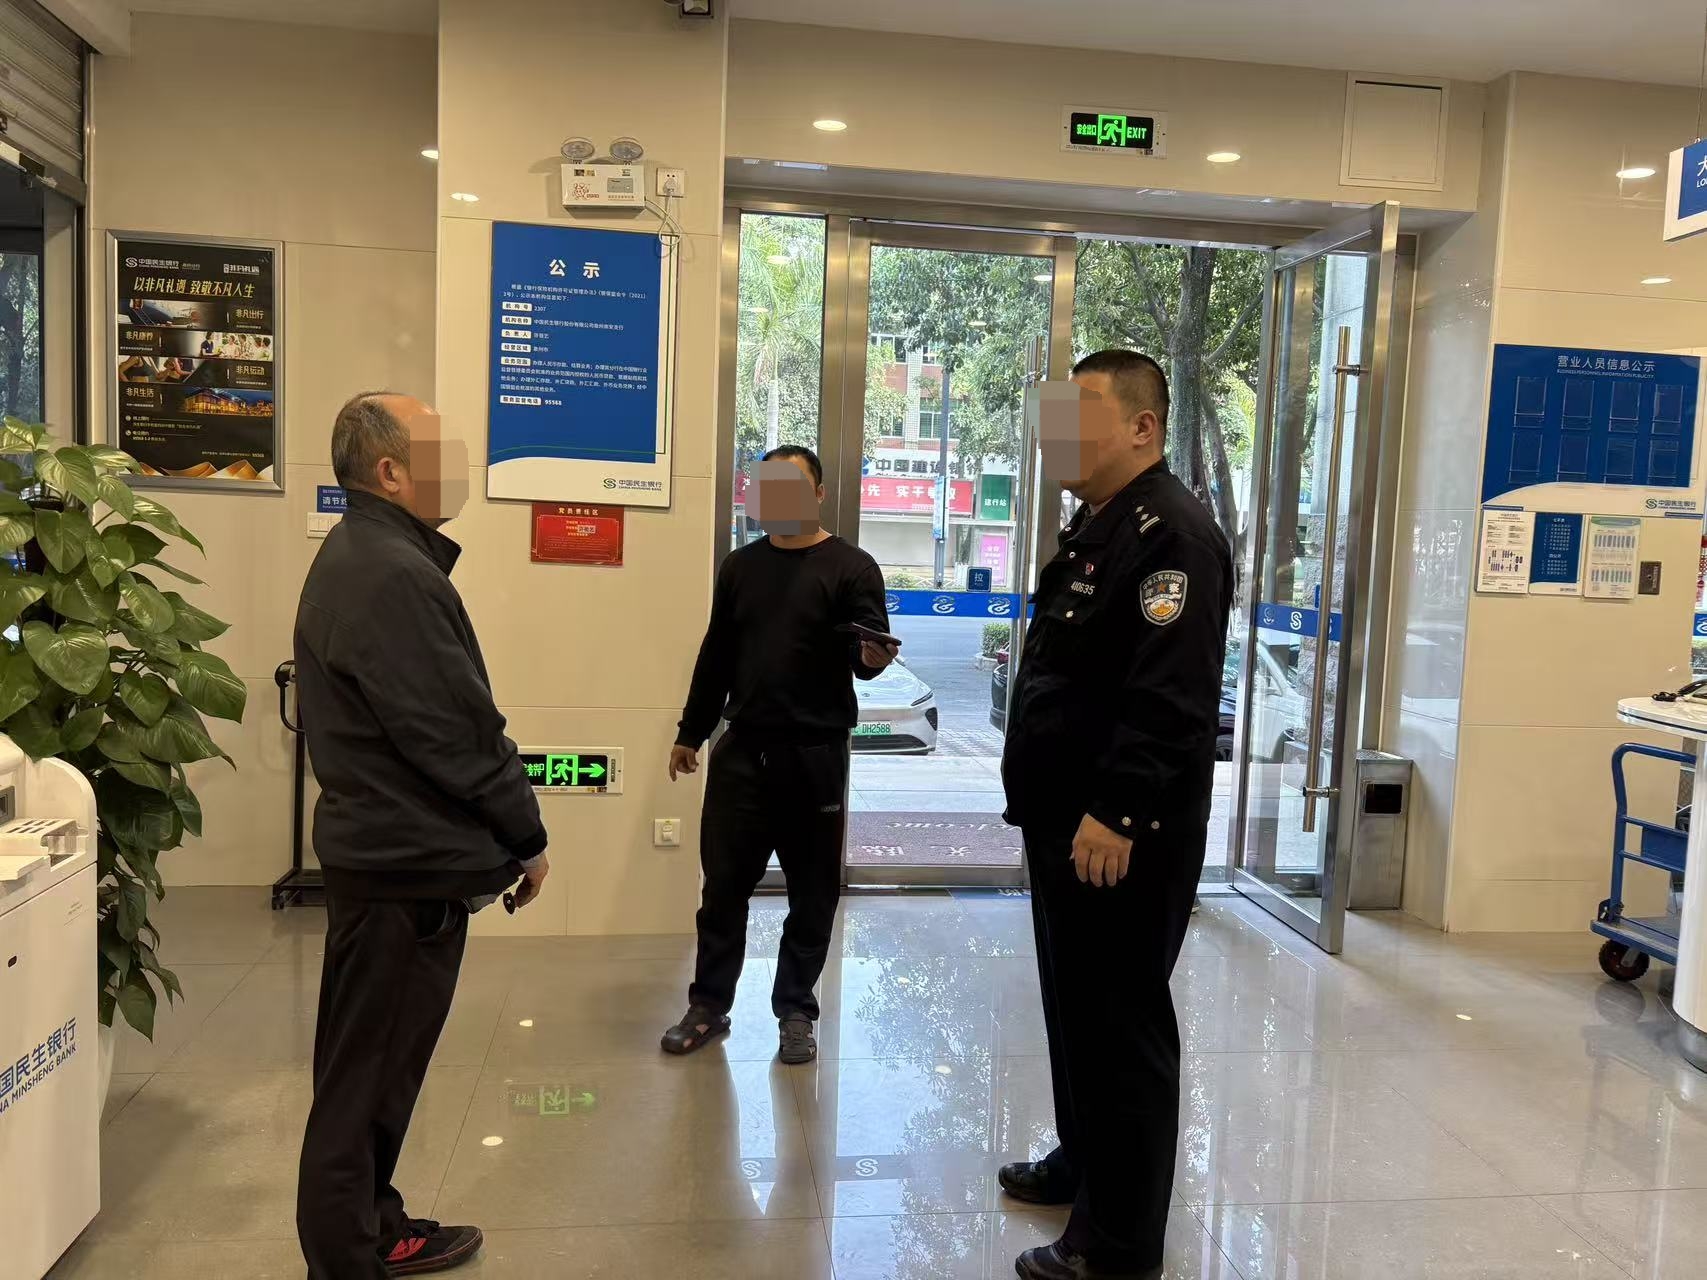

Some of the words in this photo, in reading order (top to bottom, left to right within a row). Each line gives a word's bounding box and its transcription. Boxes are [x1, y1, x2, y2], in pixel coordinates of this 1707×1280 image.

[1076, 124, 1097, 136] 安全出口
[1127, 126, 1147, 139] EXIT
[1697, 178, 1707, 188] LO
[138, 258, 179, 266] 中国民生银行
[549, 259, 600, 279] 公示
[134, 276, 187, 294] 以非凡礼遇
[190, 280, 255, 298] 致敬不凡人生
[235, 308, 264, 320] 非凡出行
[1557, 355, 1656, 373] 营业人员信息公示
[236, 365, 265, 376] 非凡运动
[126, 387, 154, 398] 非凡生活
[619, 480, 662, 488] 中国民生银行
[1658, 500, 1696, 508] 中国民生银行
[12, 1060, 54, 1103] MINSHENG
[57, 1042, 76, 1065] BANK
